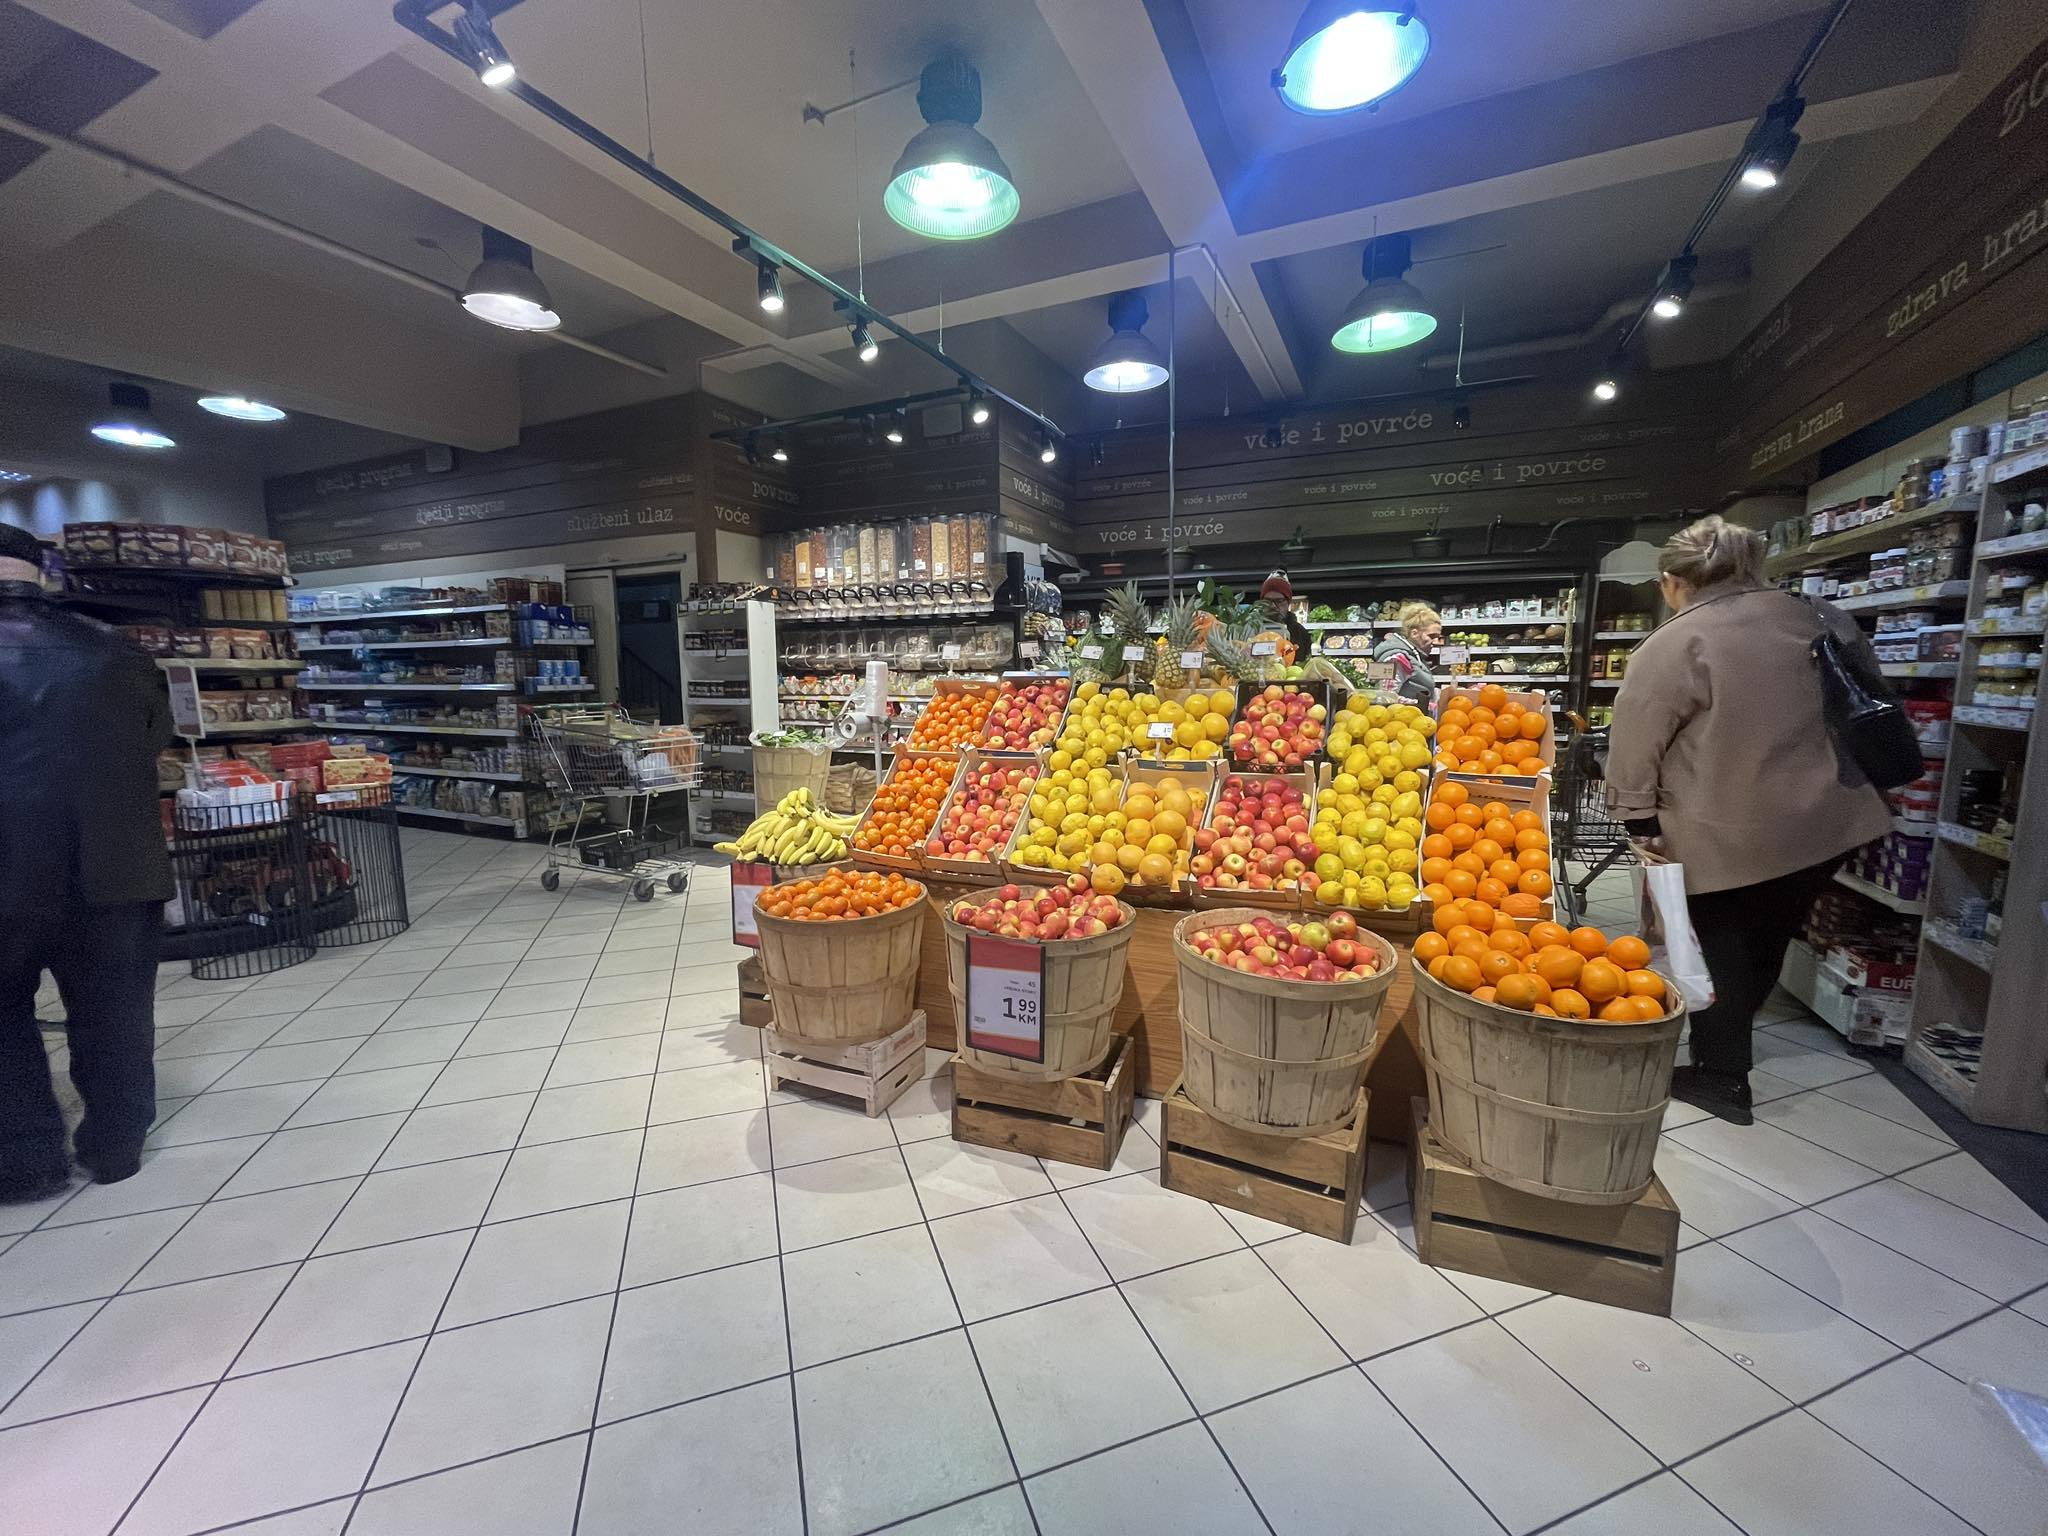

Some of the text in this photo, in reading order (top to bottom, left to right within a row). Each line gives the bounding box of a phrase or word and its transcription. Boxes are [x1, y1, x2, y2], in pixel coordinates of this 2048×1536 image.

[1311, 421, 1327, 442] i
[1336, 408, 1433, 444] povrće
[1430, 452, 1607, 486] voće i povrće
[637, 506, 674, 525] ulaz
[713, 505, 752, 525] voće
[1099, 524, 1137, 544] voće
[1144, 525, 1155, 541] i
[1018, 999, 1037, 1013] 99
[1018, 1014, 1037, 1025] KM
